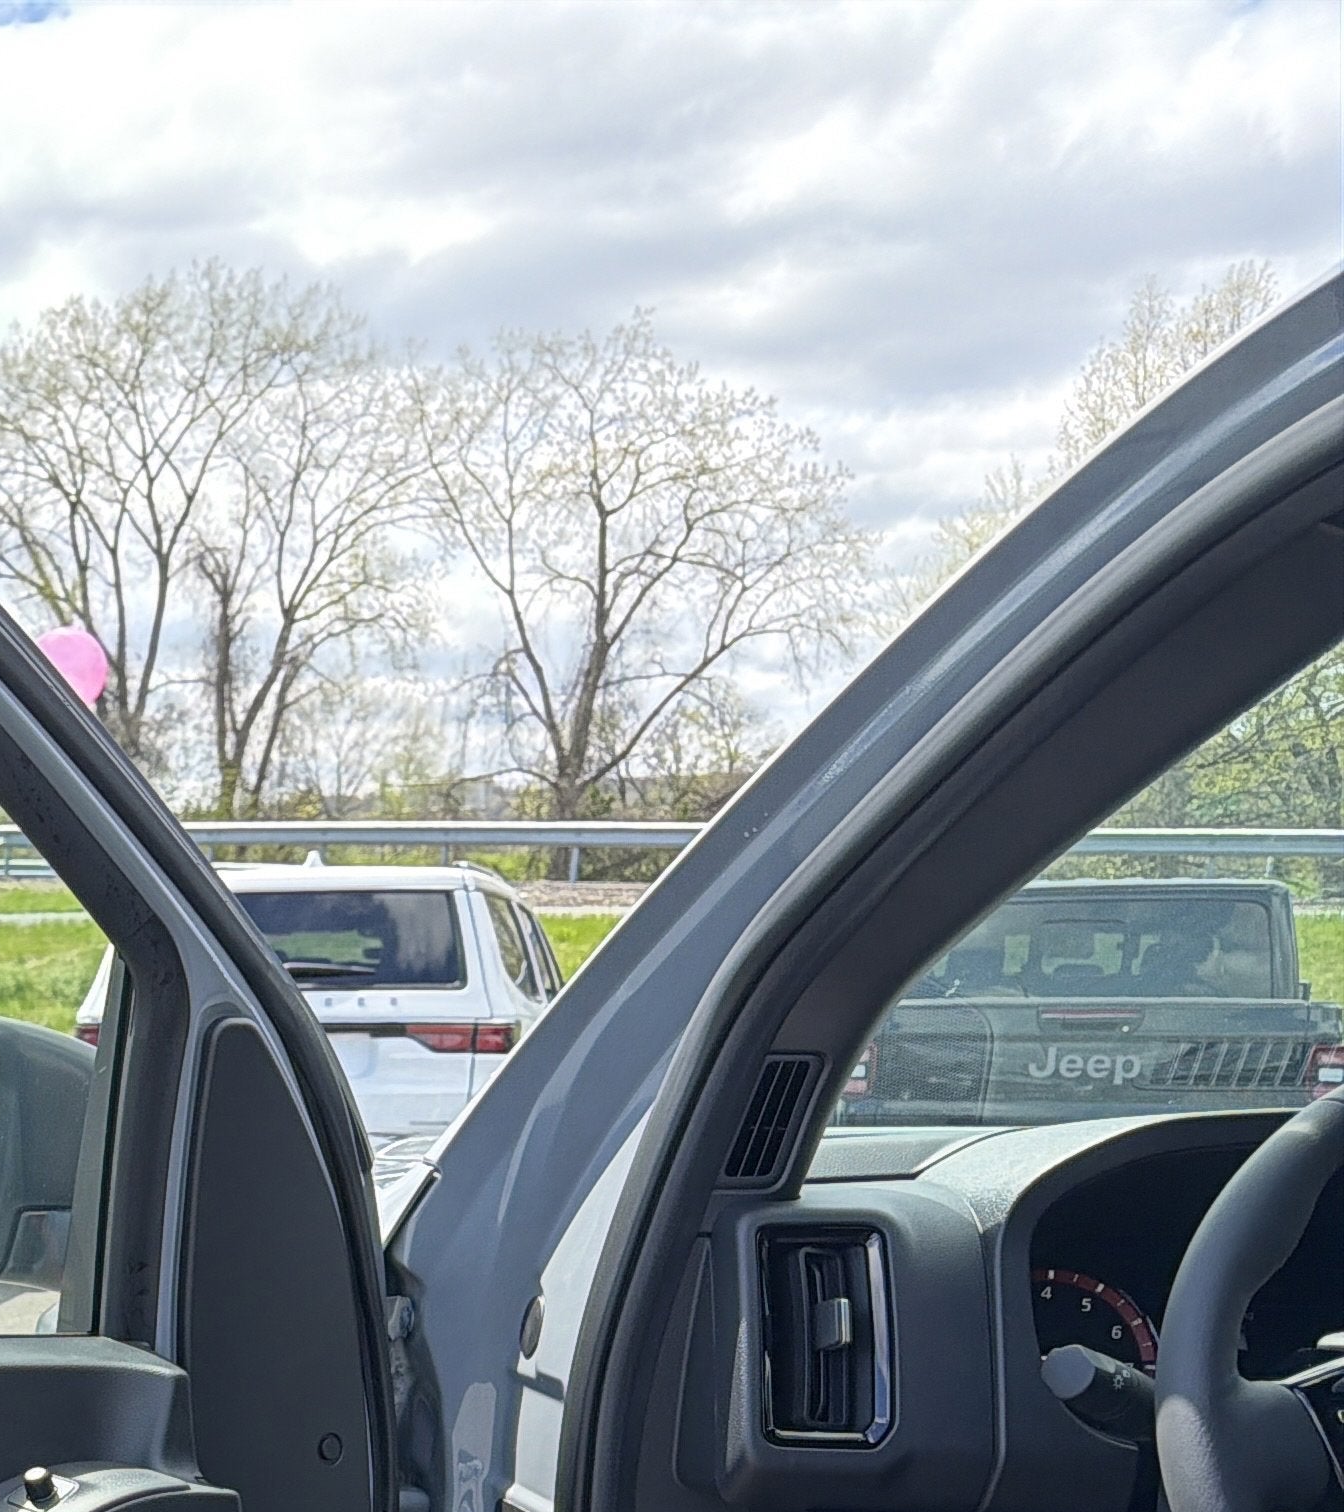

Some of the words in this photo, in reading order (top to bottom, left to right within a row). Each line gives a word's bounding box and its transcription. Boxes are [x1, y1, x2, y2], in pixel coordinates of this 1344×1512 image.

[1028, 1046, 1141, 1085] Jeep
[1040, 1286, 1052, 1299] 4
[1081, 1298, 1092, 1312] 5
[1111, 1325, 1123, 1339] 6
